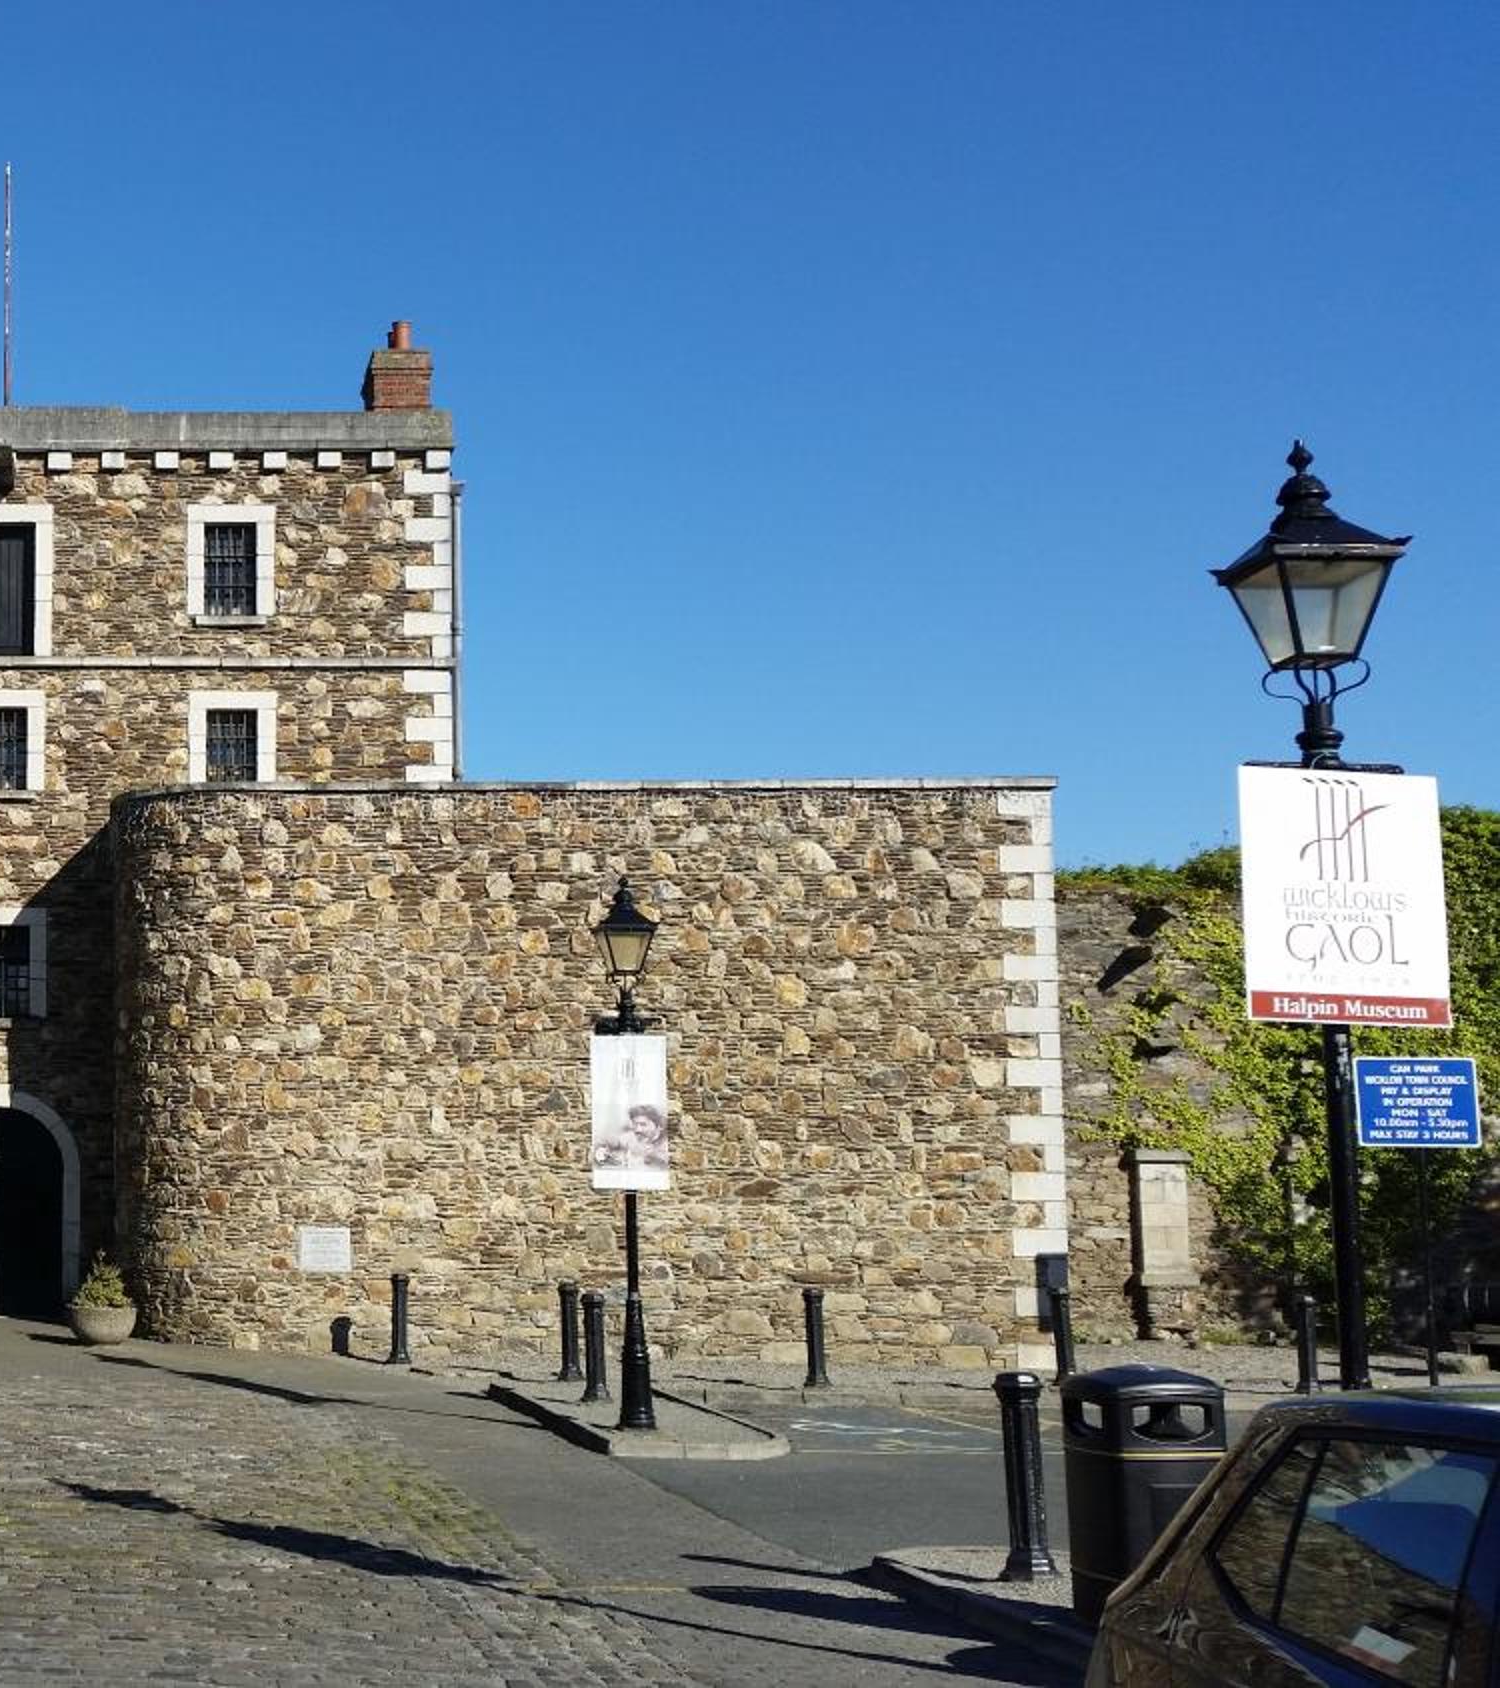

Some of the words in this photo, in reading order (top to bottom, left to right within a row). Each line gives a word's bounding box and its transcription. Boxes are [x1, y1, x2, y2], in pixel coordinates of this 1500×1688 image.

[1273, 997, 1339, 1018] Halpin
[1344, 999, 1428, 1019] Museum
[1390, 1065, 1411, 1073] CAR
[1414, 1065, 1440, 1073] PARK
[1405, 1076, 1429, 1084] TOWN
[1431, 1076, 1468, 1085] COUNCIL
[1402, 1087, 1409, 1095] &
[1412, 1087, 1452, 1095] DISPLAY
[1397, 1098, 1453, 1106] OPERATION
[1391, 1109, 1419, 1117] MON
[1427, 1109, 1447, 1117] SAT
[1369, 1130, 1393, 1139] MAX
[1395, 1130, 1419, 1139] STAY
[1433, 1130, 1469, 1140] HOURS
